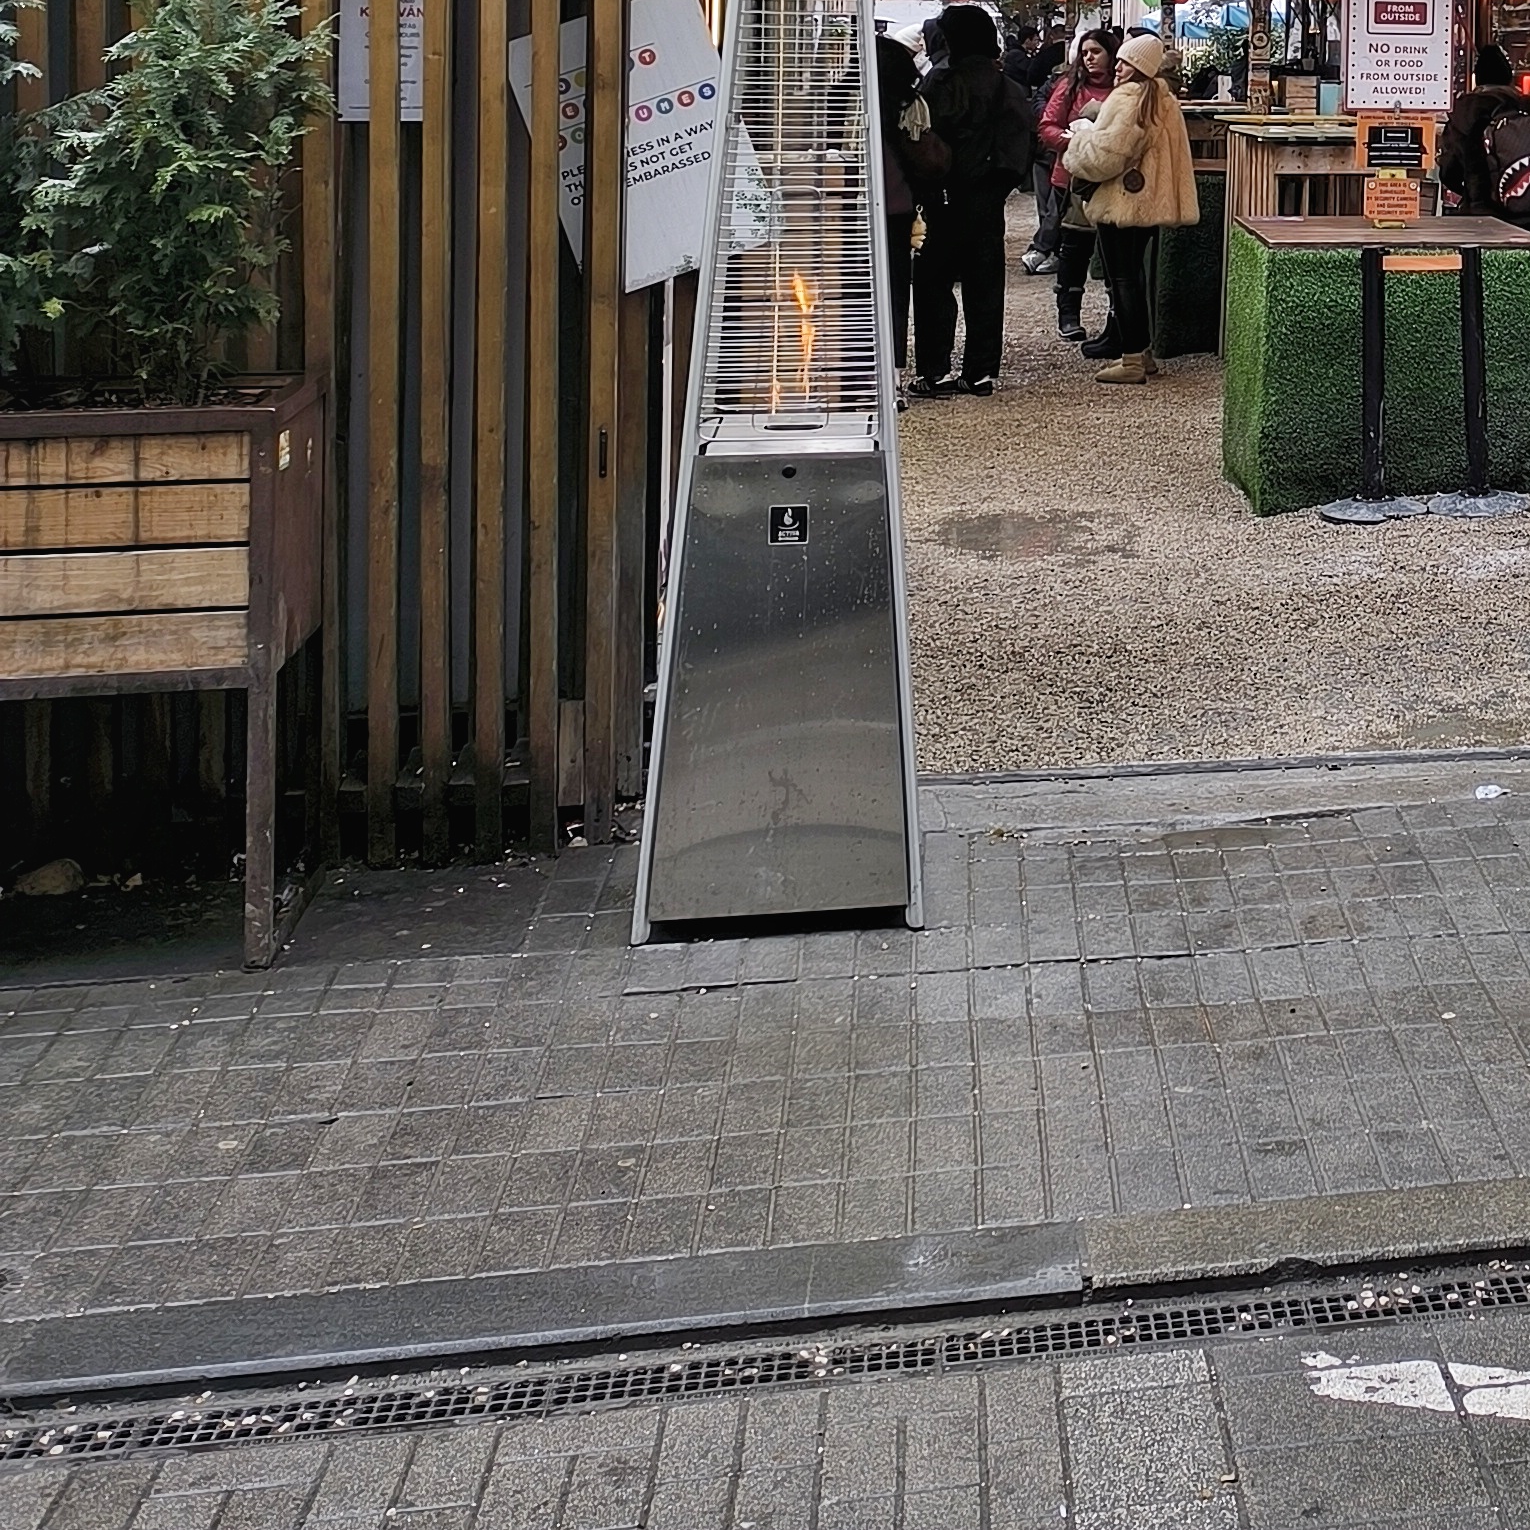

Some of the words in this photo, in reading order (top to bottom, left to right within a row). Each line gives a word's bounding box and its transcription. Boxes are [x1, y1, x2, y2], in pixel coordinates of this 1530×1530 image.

[1386, 4, 1414, 13] FROM
[1380, 11, 1421, 21] OUTSIDE
[1368, 42, 1390, 54] NO
[1394, 45, 1428, 55] DRINK
[1375, 58, 1391, 68] OR
[1394, 59, 1423, 68] FOOD
[1360, 72, 1390, 81] FROM
[1393, 72, 1439, 82] OUTSIDE
[1372, 85, 1426, 95] ALLOWED!
[656, 135, 671, 148] IN
[673, 132, 684, 142] A
[684, 120, 715, 137] WAY
[639, 150, 667, 168] NOT
[669, 141, 694, 158] GET
